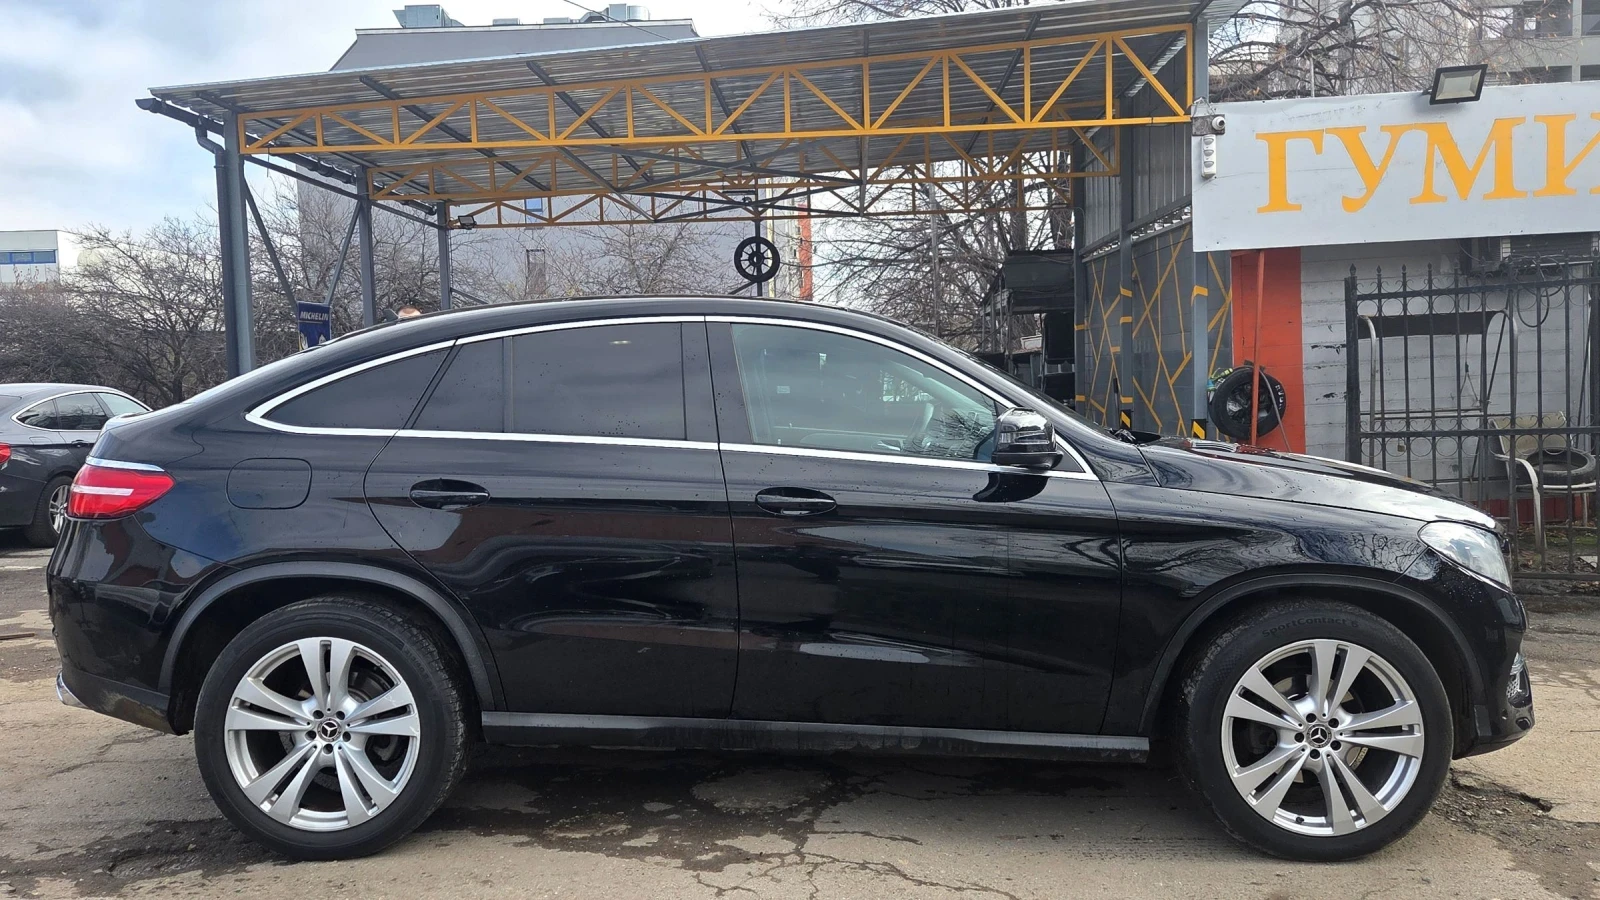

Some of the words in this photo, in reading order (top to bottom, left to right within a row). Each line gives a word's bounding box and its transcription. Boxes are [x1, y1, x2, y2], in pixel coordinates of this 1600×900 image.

[1255, 113, 1600, 213] ГУМИ
[300, 311, 329, 321] MICHELIN
[1262, 616, 1347, 638] SportContact
